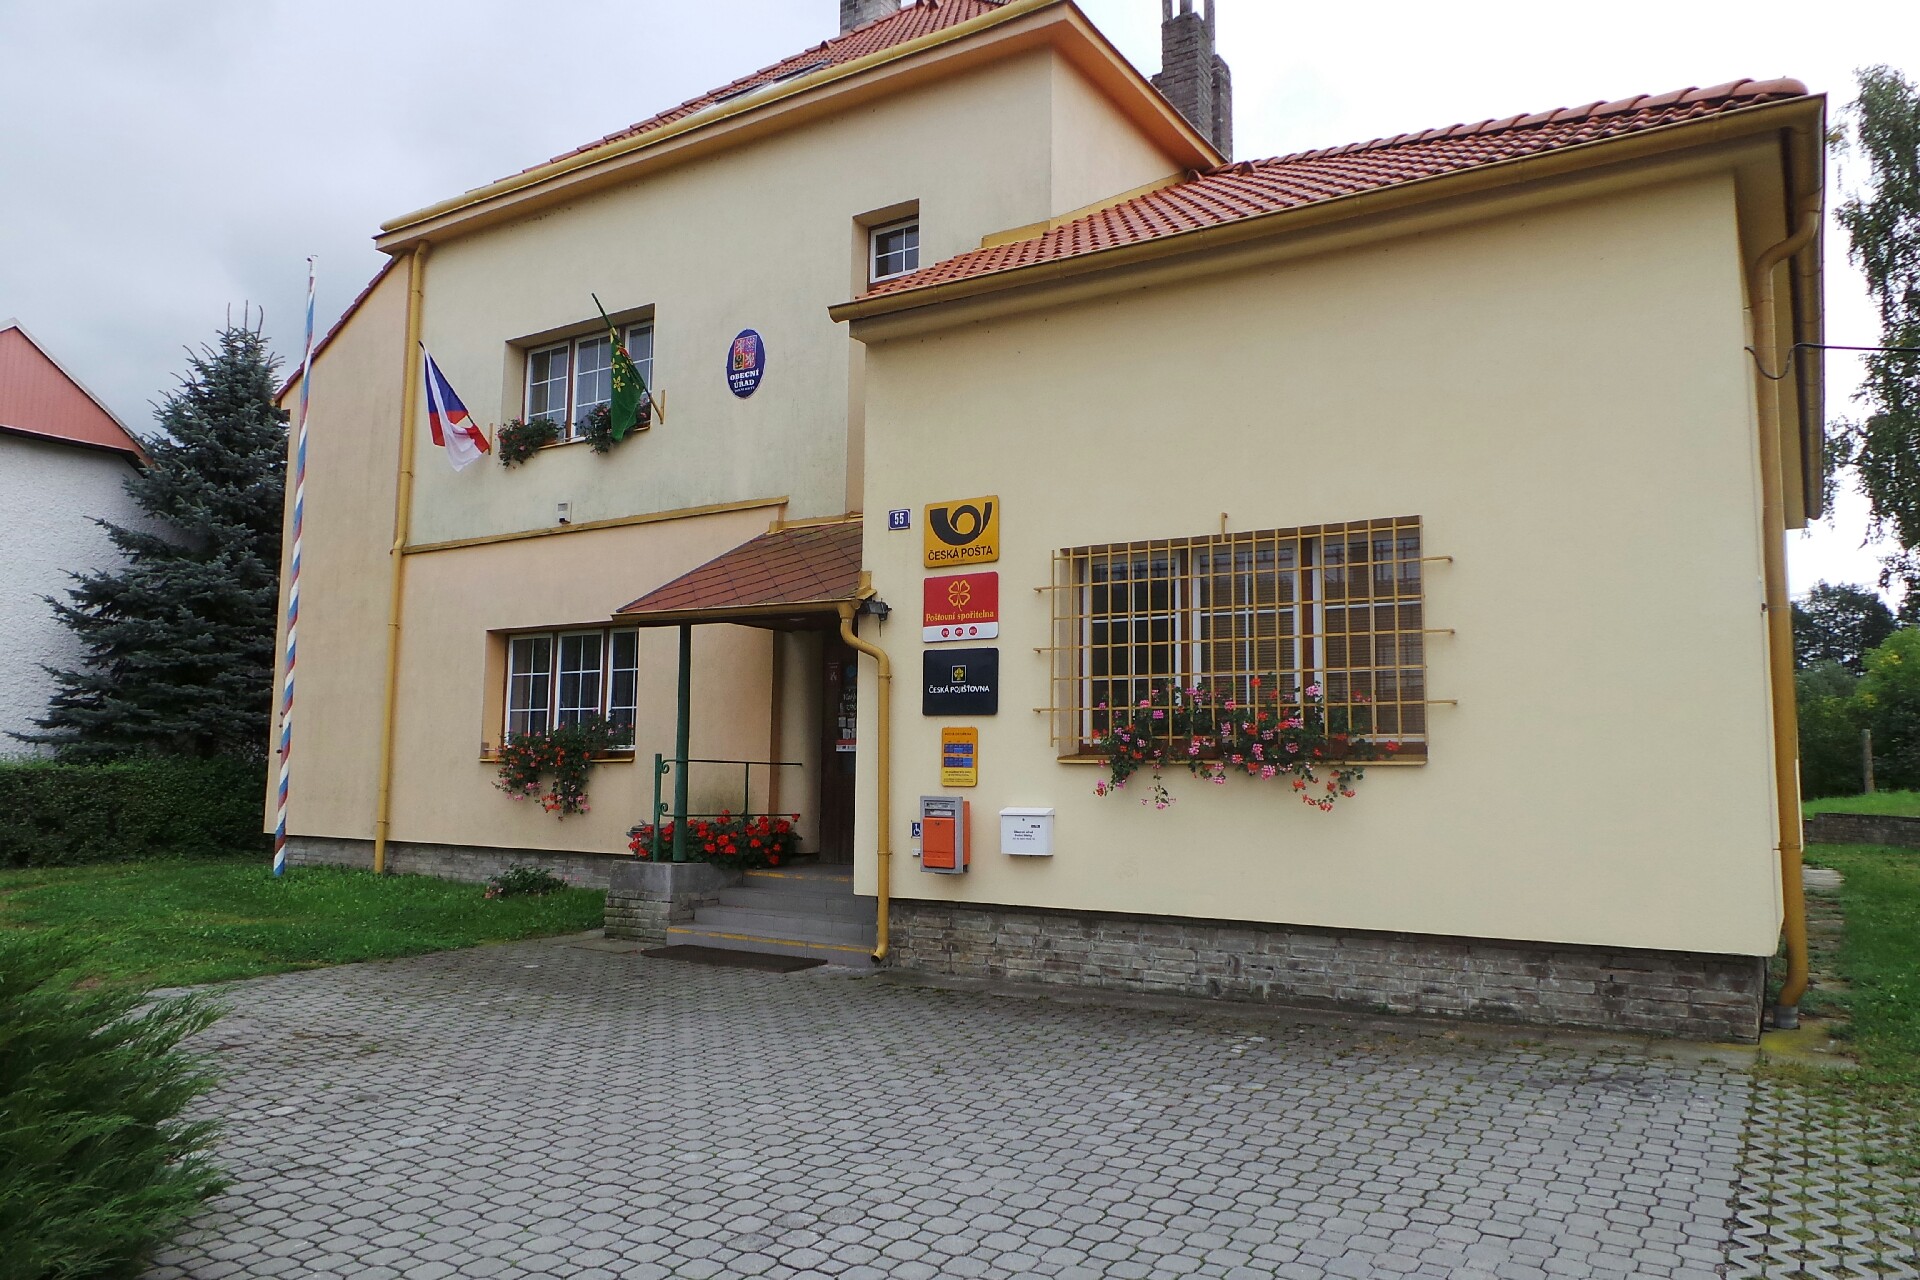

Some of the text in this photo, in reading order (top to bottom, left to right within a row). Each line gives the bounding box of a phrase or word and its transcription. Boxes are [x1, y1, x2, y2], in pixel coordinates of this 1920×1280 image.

[730, 368, 759, 380] OBECNÍ
[734, 379, 754, 388] ÚŘAD
[894, 512, 905, 525] 55
[928, 545, 993, 561] ČESKÁ POŠTA
[926, 609, 994, 622] Poštovní spořitelna
[928, 684, 990, 694] ČESKÁ POJIŠŤOVNA
